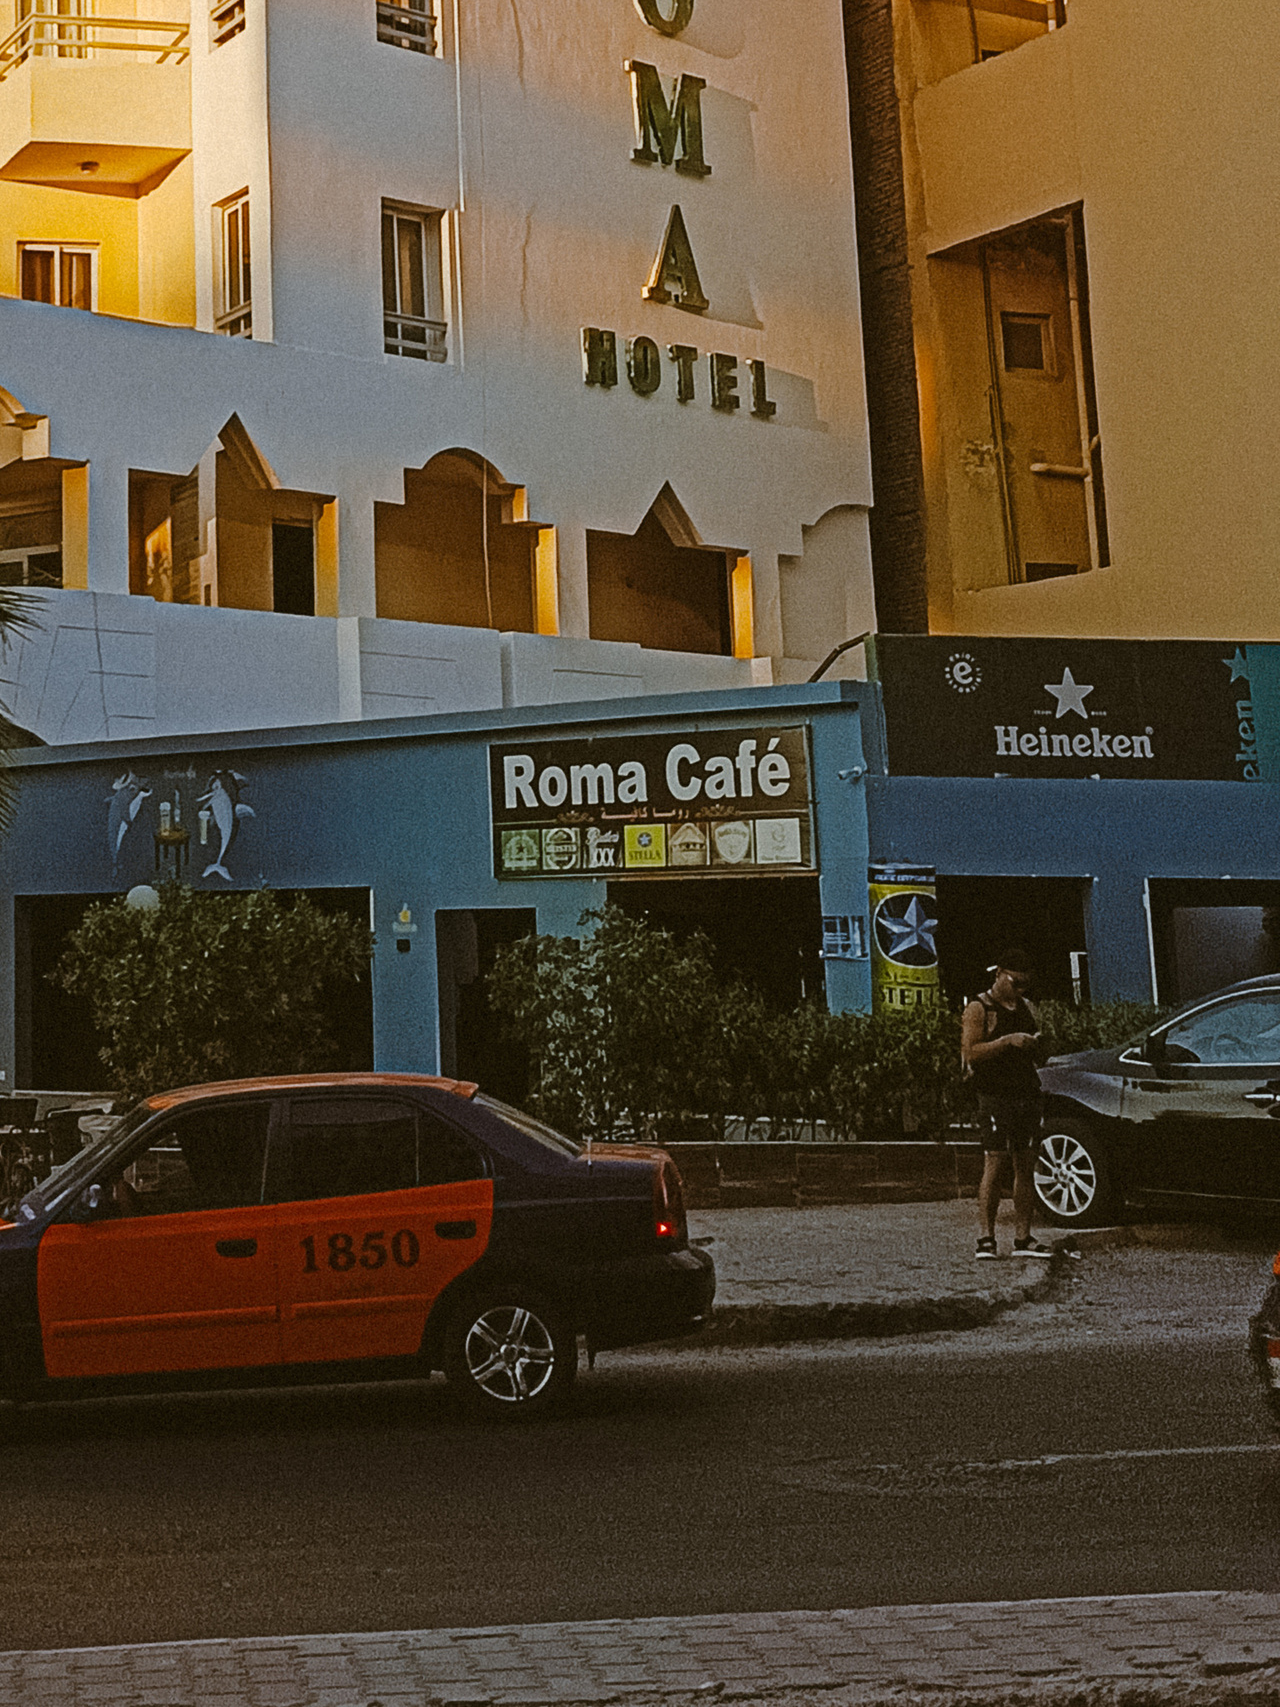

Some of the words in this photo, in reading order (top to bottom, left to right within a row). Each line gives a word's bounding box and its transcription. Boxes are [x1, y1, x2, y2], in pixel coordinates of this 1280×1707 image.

[580, 327, 777, 417] HOTEL
[994, 725, 1155, 759] Heineken
[503, 754, 648, 809] Roma
[666, 737, 791, 801] Café
[628, 848, 662, 862] STELLA
[299, 1228, 421, 1274] 1850
